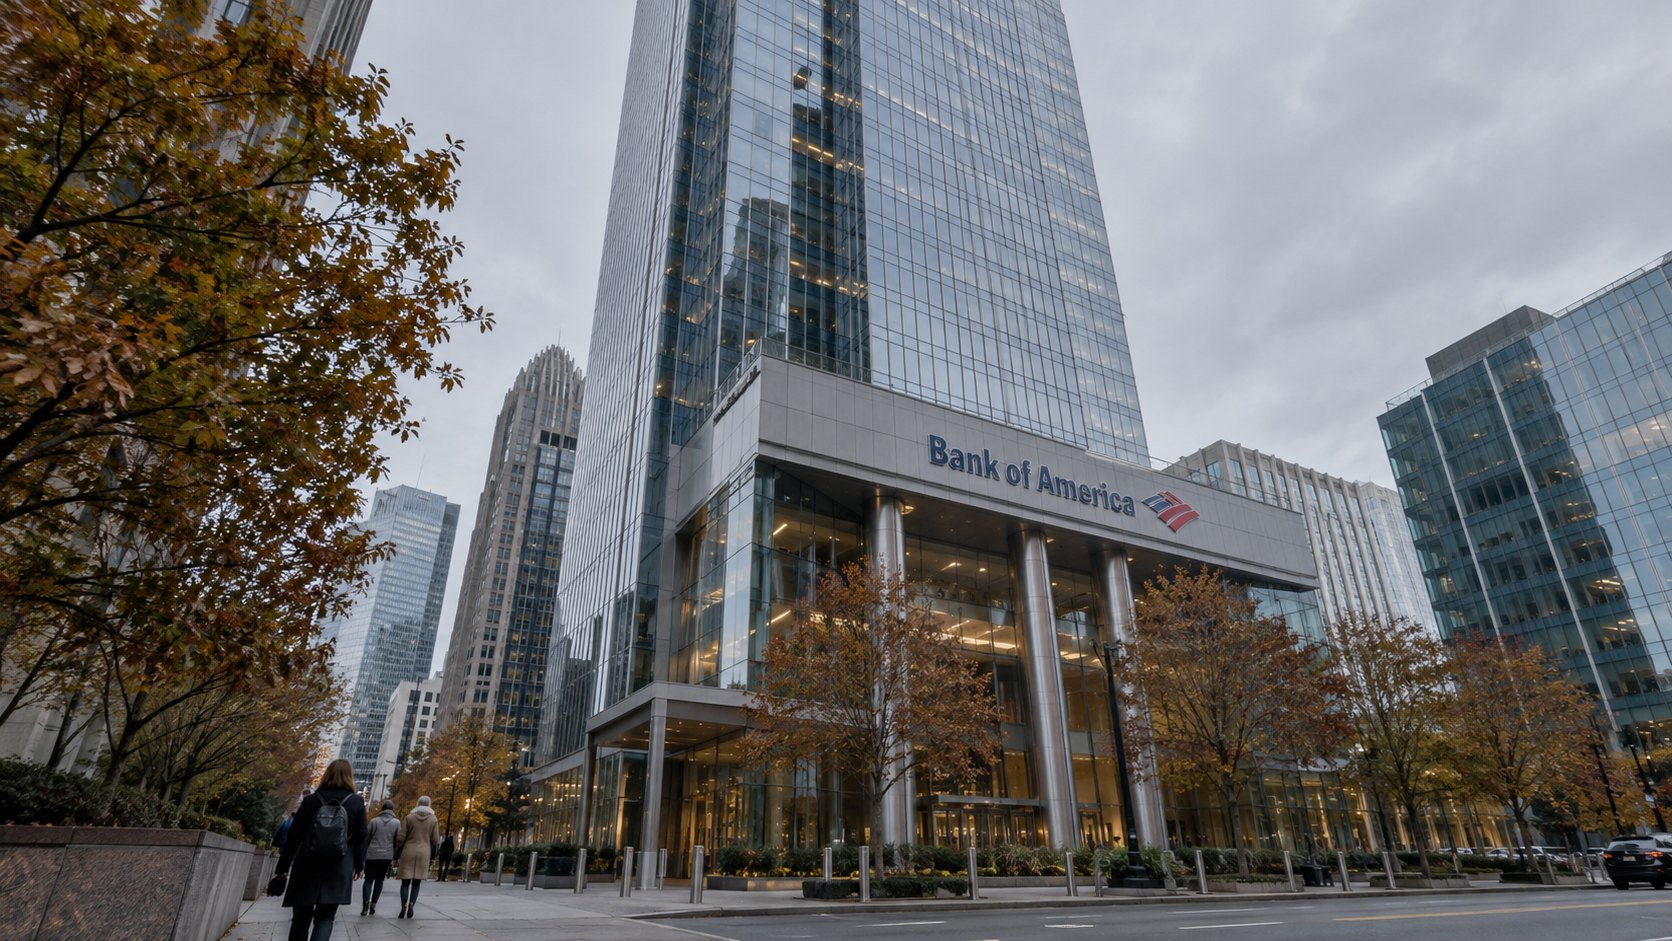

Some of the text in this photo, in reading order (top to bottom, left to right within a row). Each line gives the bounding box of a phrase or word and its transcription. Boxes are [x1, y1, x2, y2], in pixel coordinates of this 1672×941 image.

[928, 433, 1136, 517] Bank of America
